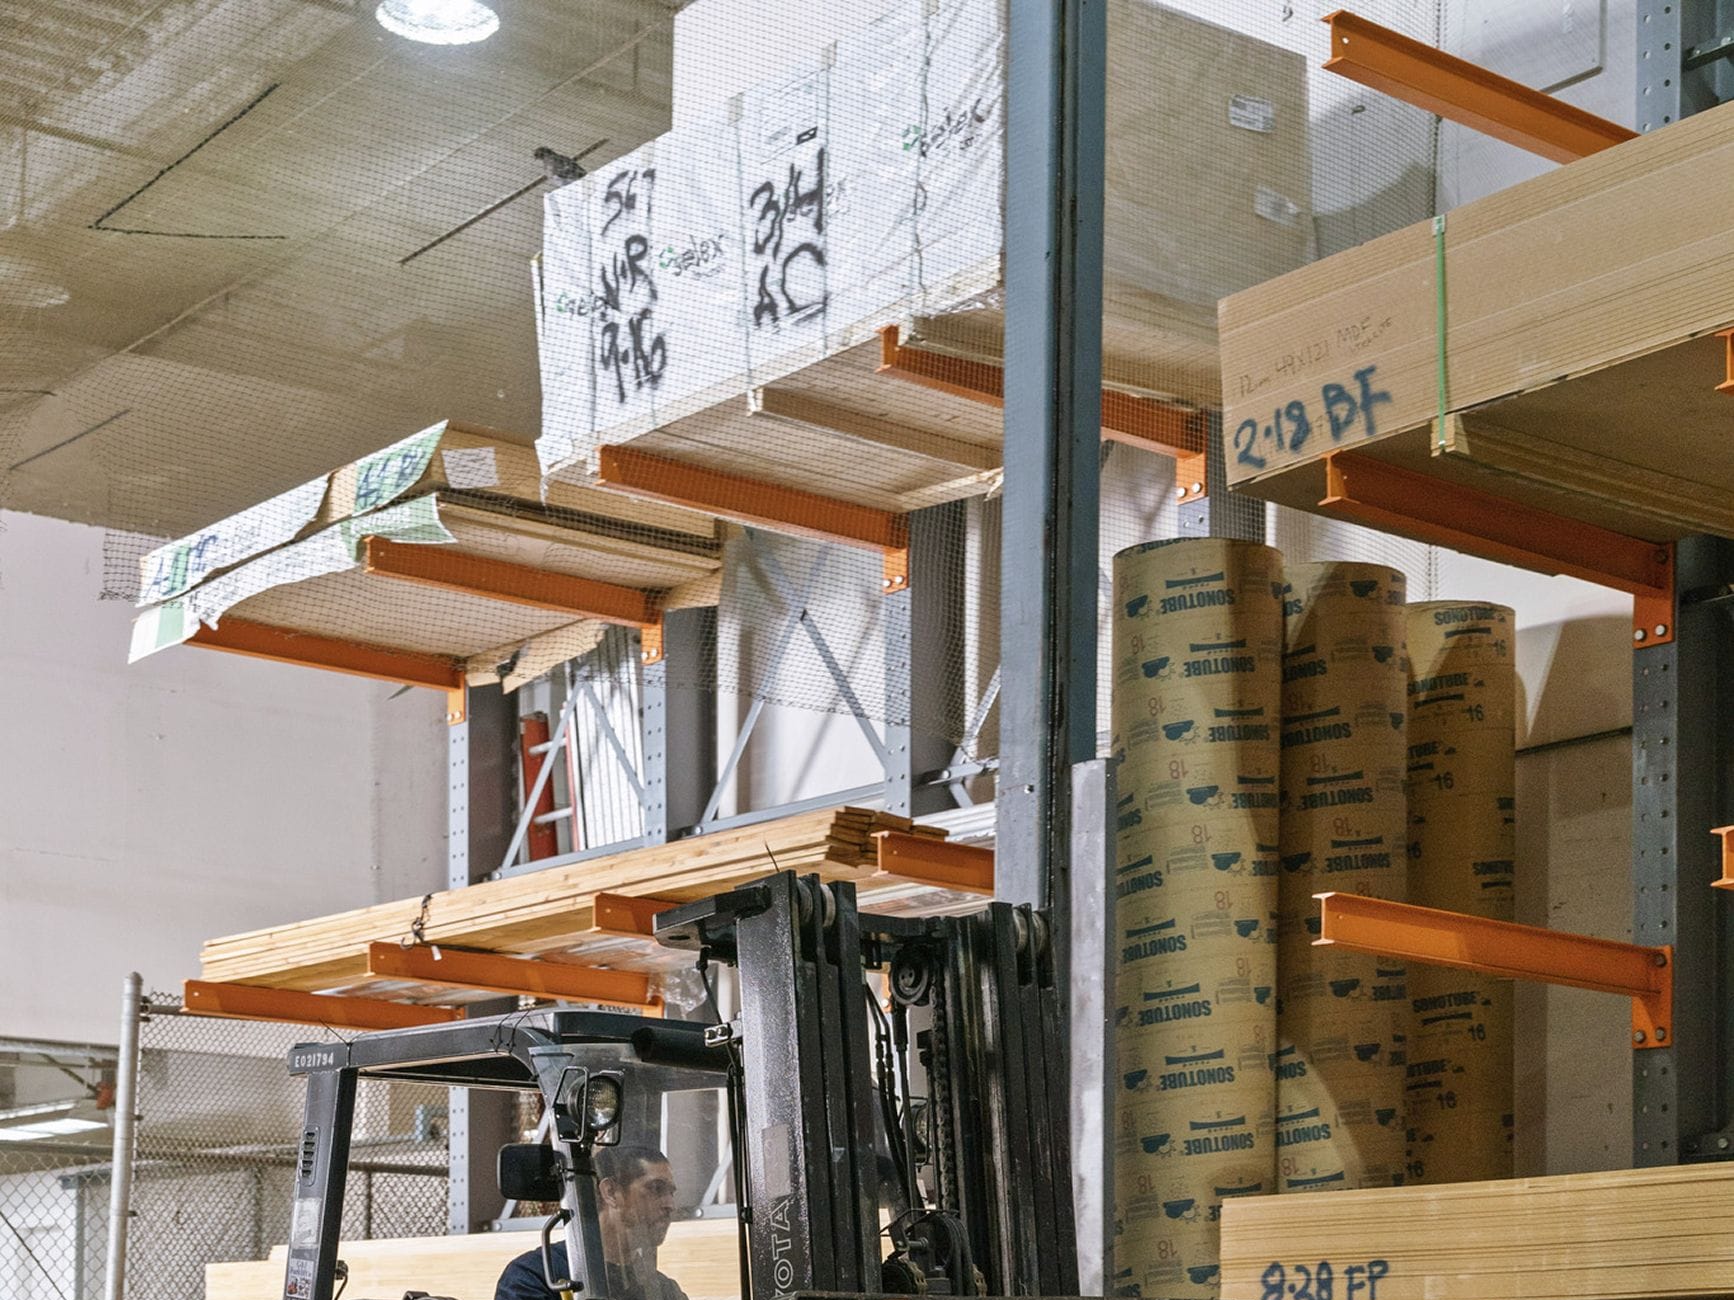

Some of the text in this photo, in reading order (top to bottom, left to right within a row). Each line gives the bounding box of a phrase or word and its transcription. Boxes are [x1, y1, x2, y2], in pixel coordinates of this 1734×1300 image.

[1321, 364, 1393, 442] BF
[1160, 588, 1236, 614] SONOTUBE
[1183, 656, 1256, 678] SONOTUBE
[1207, 724, 1271, 743] SONOTUBE
[1122, 934, 1187, 964] SONOTUBE
[1140, 1000, 1212, 1026] SONOTUBE
[294, 1052, 334, 1068] E021794
[1160, 1066, 1236, 1091] SONOTUBE
[1184, 1132, 1255, 1155] SONOTUBE
